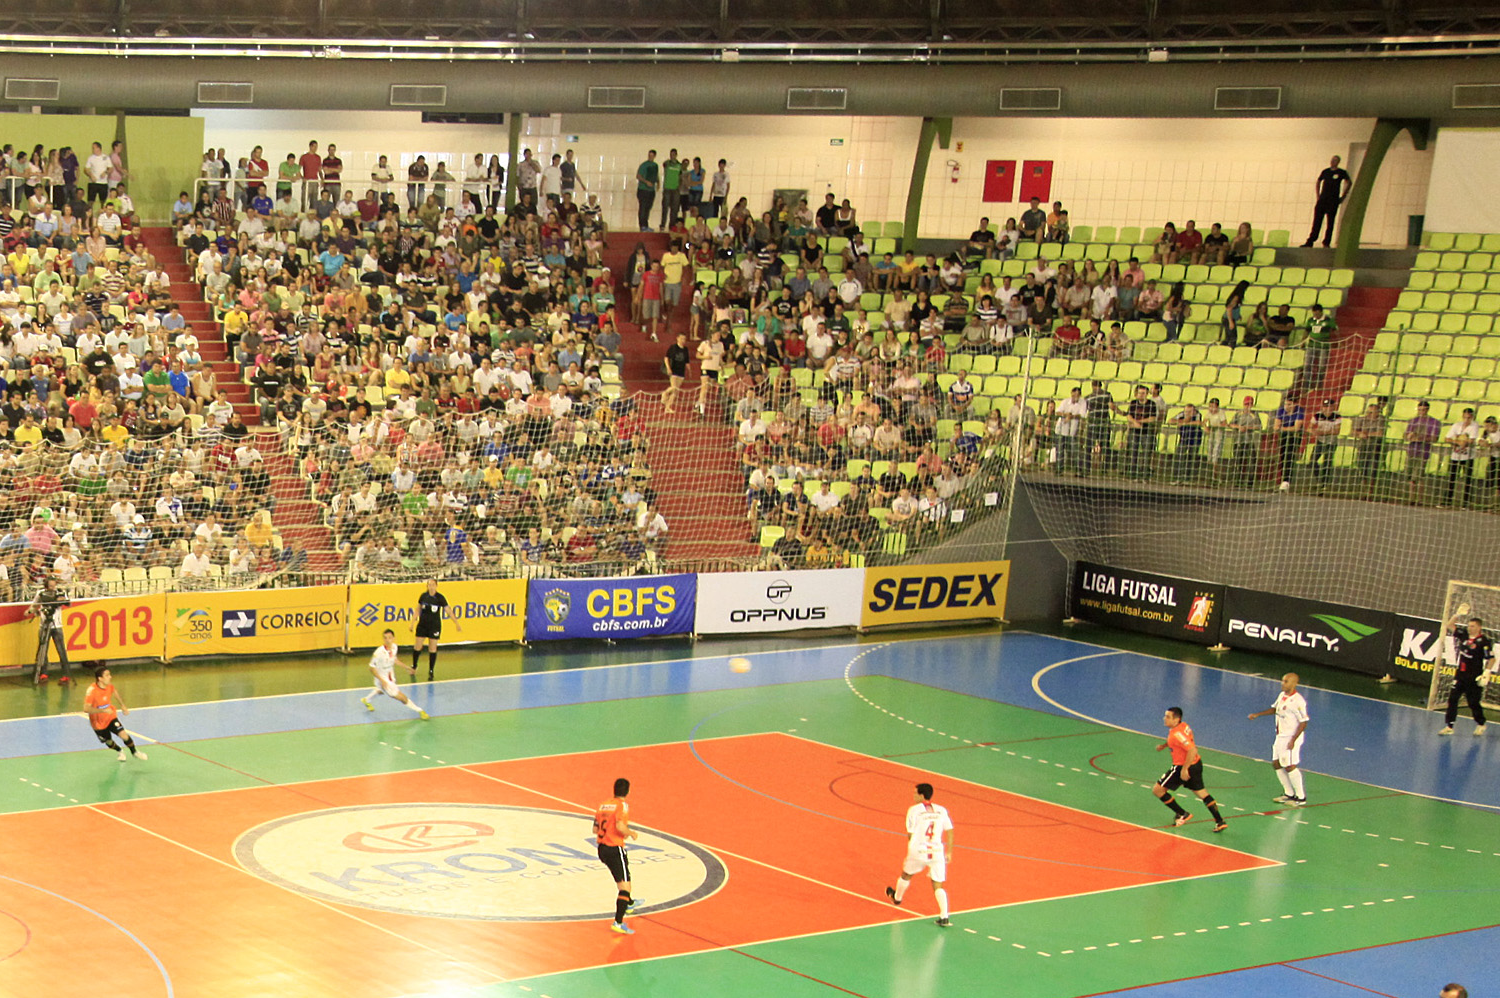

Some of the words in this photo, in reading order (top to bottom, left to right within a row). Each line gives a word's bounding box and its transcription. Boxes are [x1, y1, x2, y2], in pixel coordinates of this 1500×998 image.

[868, 573, 1003, 613] SEDEX
[1082, 571, 1116, 595] LIGA
[1120, 579, 1177, 607] FUTSAL
[465, 602, 517, 618] BRASIL
[586, 585, 676, 618] CBFS
[1080, 598, 1173, 622] www.ligafutsal.com.br
[261, 610, 339, 629] CORREIOS
[592, 617, 668, 631] cbfs.com.br
[730, 607, 826, 622] OPPNUS
[66, 606, 154, 650] 2013
[190, 620, 212, 632] 350
[1228, 619, 1339, 651] PENALTY
[1395, 656, 1418, 670] BOLA
[925, 821, 935, 840] 4
[309, 837, 664, 891] KRONA
